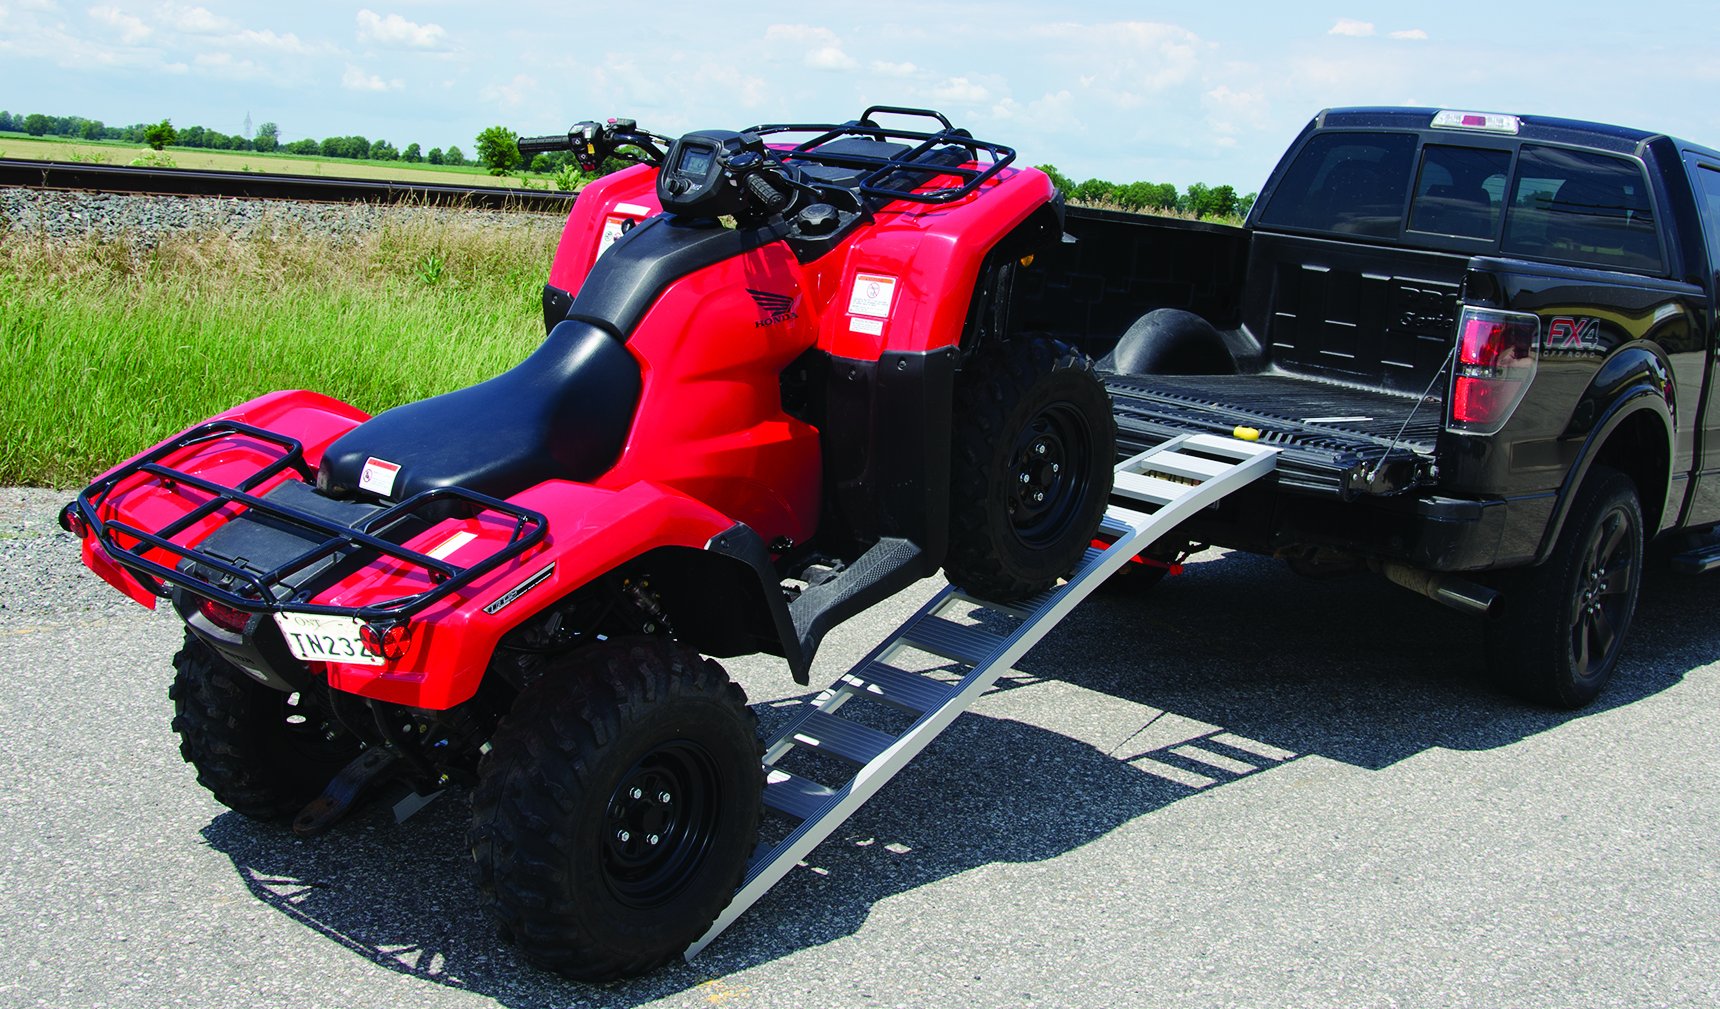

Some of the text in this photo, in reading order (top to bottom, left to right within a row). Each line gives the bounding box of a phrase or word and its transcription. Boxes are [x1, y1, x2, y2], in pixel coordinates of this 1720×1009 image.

[754, 312, 799, 328] HONDA
[1546, 317, 1600, 348] FX4
[1542, 350, 1596, 359] OFF ROAD
